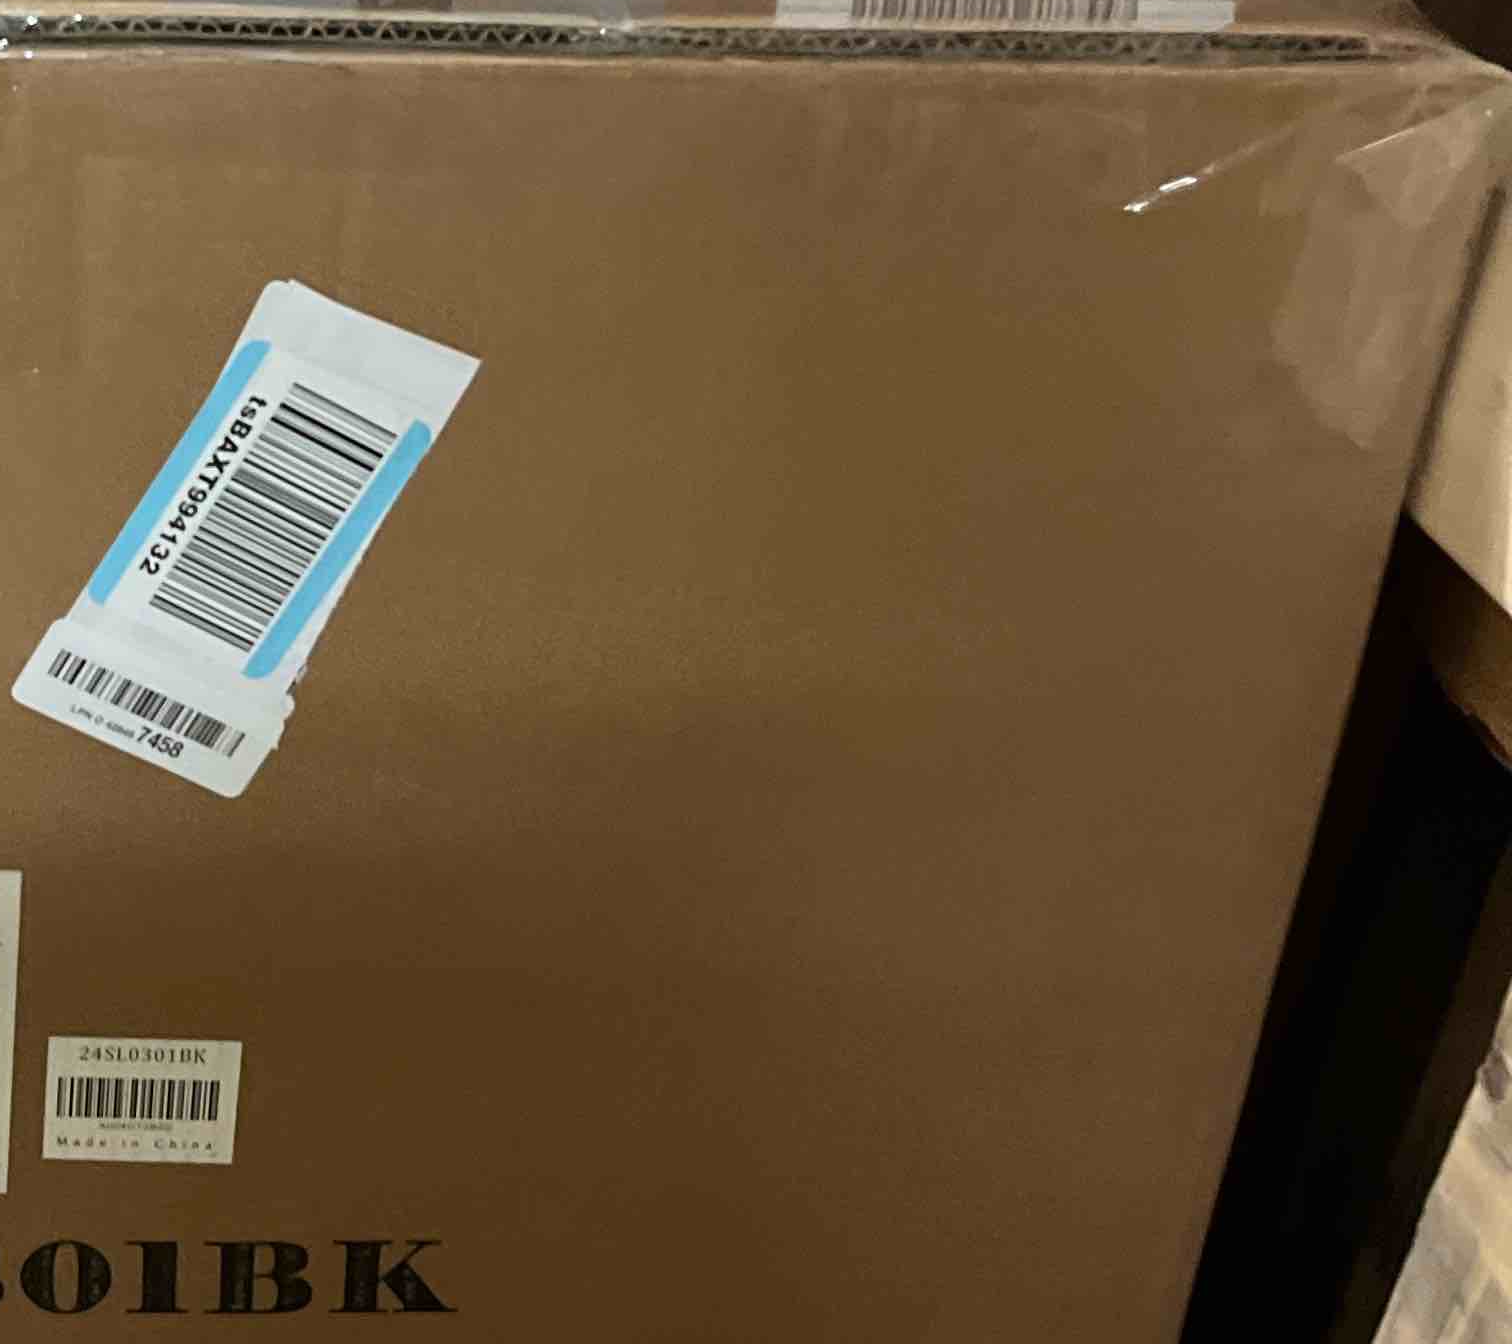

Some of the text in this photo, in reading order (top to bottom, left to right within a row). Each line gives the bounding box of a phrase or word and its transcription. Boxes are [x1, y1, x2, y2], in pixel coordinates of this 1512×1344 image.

[139, 394, 268, 576] tsBAXT994132
[136, 725, 185, 759] 7458
[79, 1044, 208, 1065] 24SL0301BK
[56, 1136, 214, 1151] Made in China
